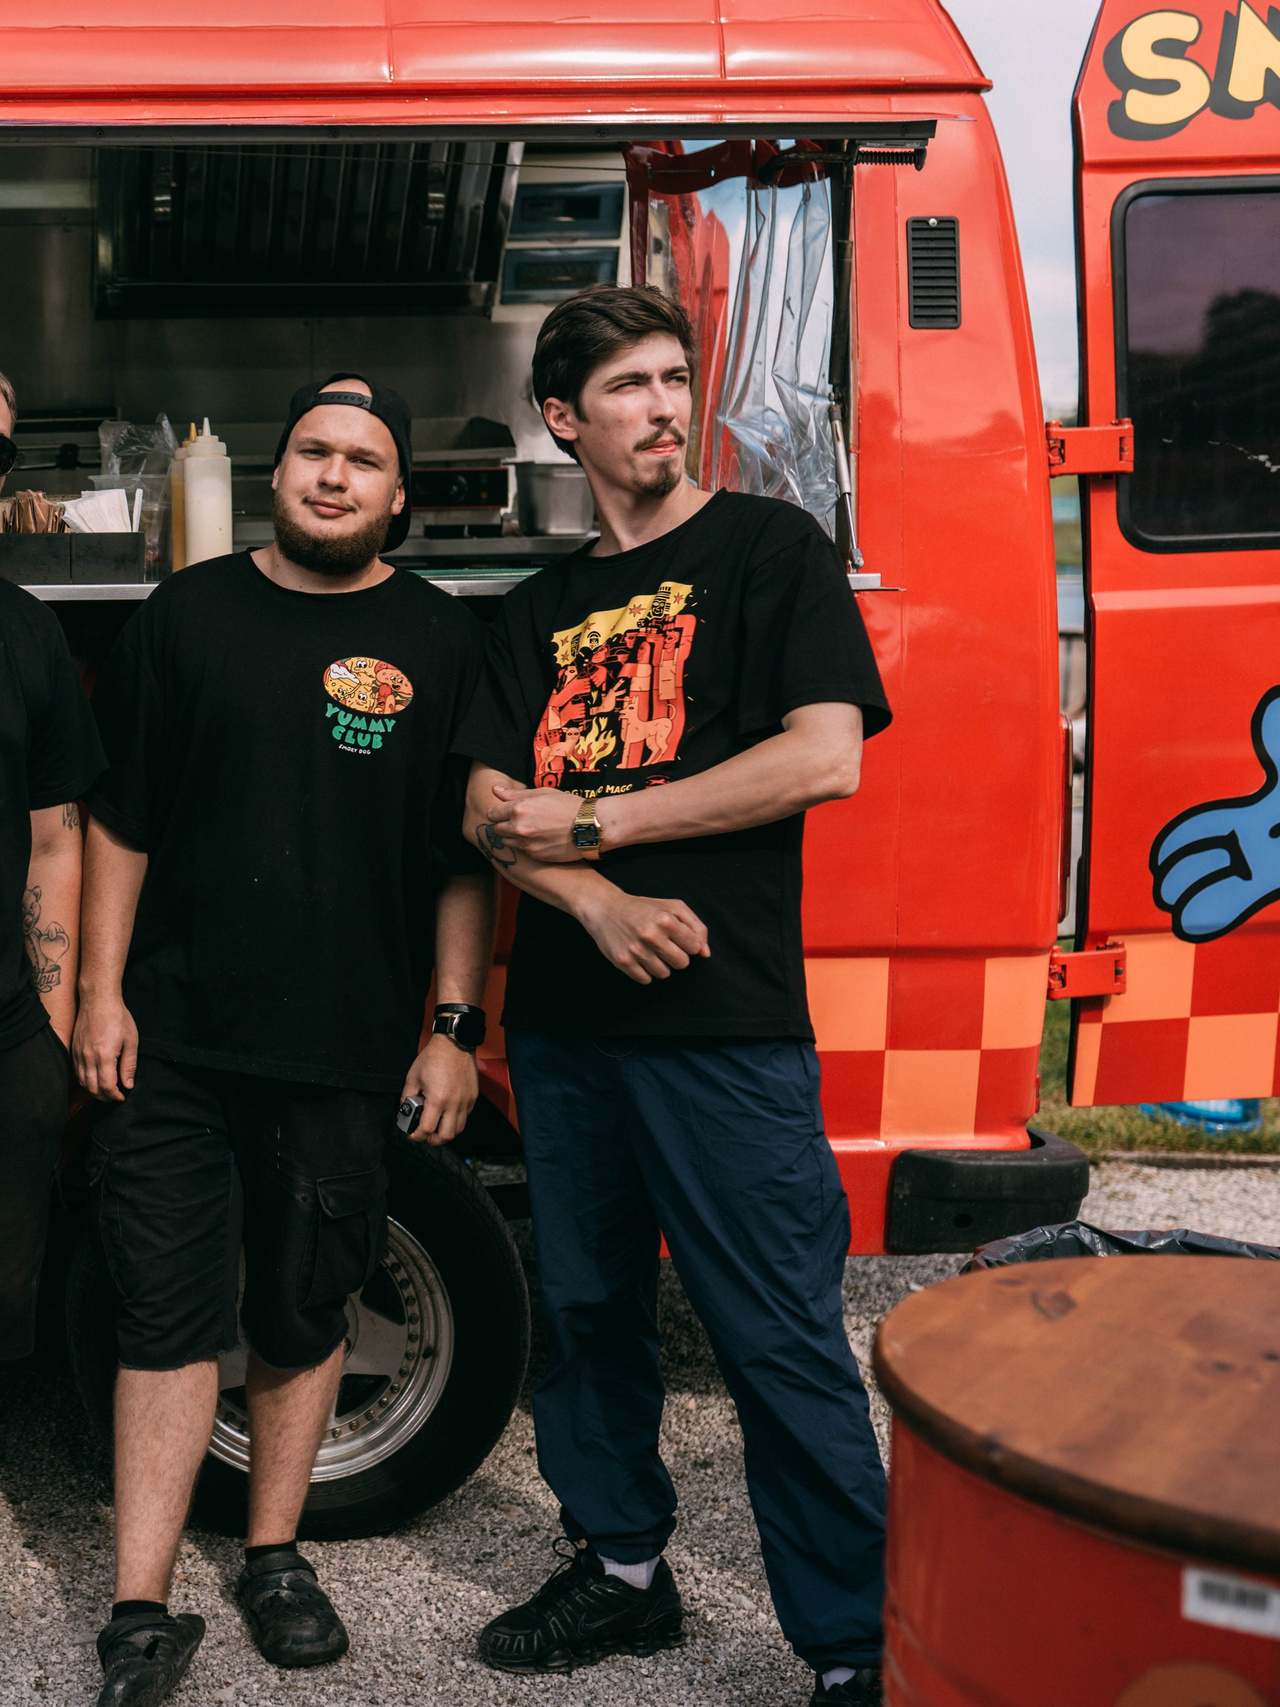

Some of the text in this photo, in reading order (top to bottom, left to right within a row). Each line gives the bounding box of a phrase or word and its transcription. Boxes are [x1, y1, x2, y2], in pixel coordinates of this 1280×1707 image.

[325, 702, 397, 733] YUMMY
[332, 725, 383, 749] CLUB
[605, 783, 633, 794] MAGO
